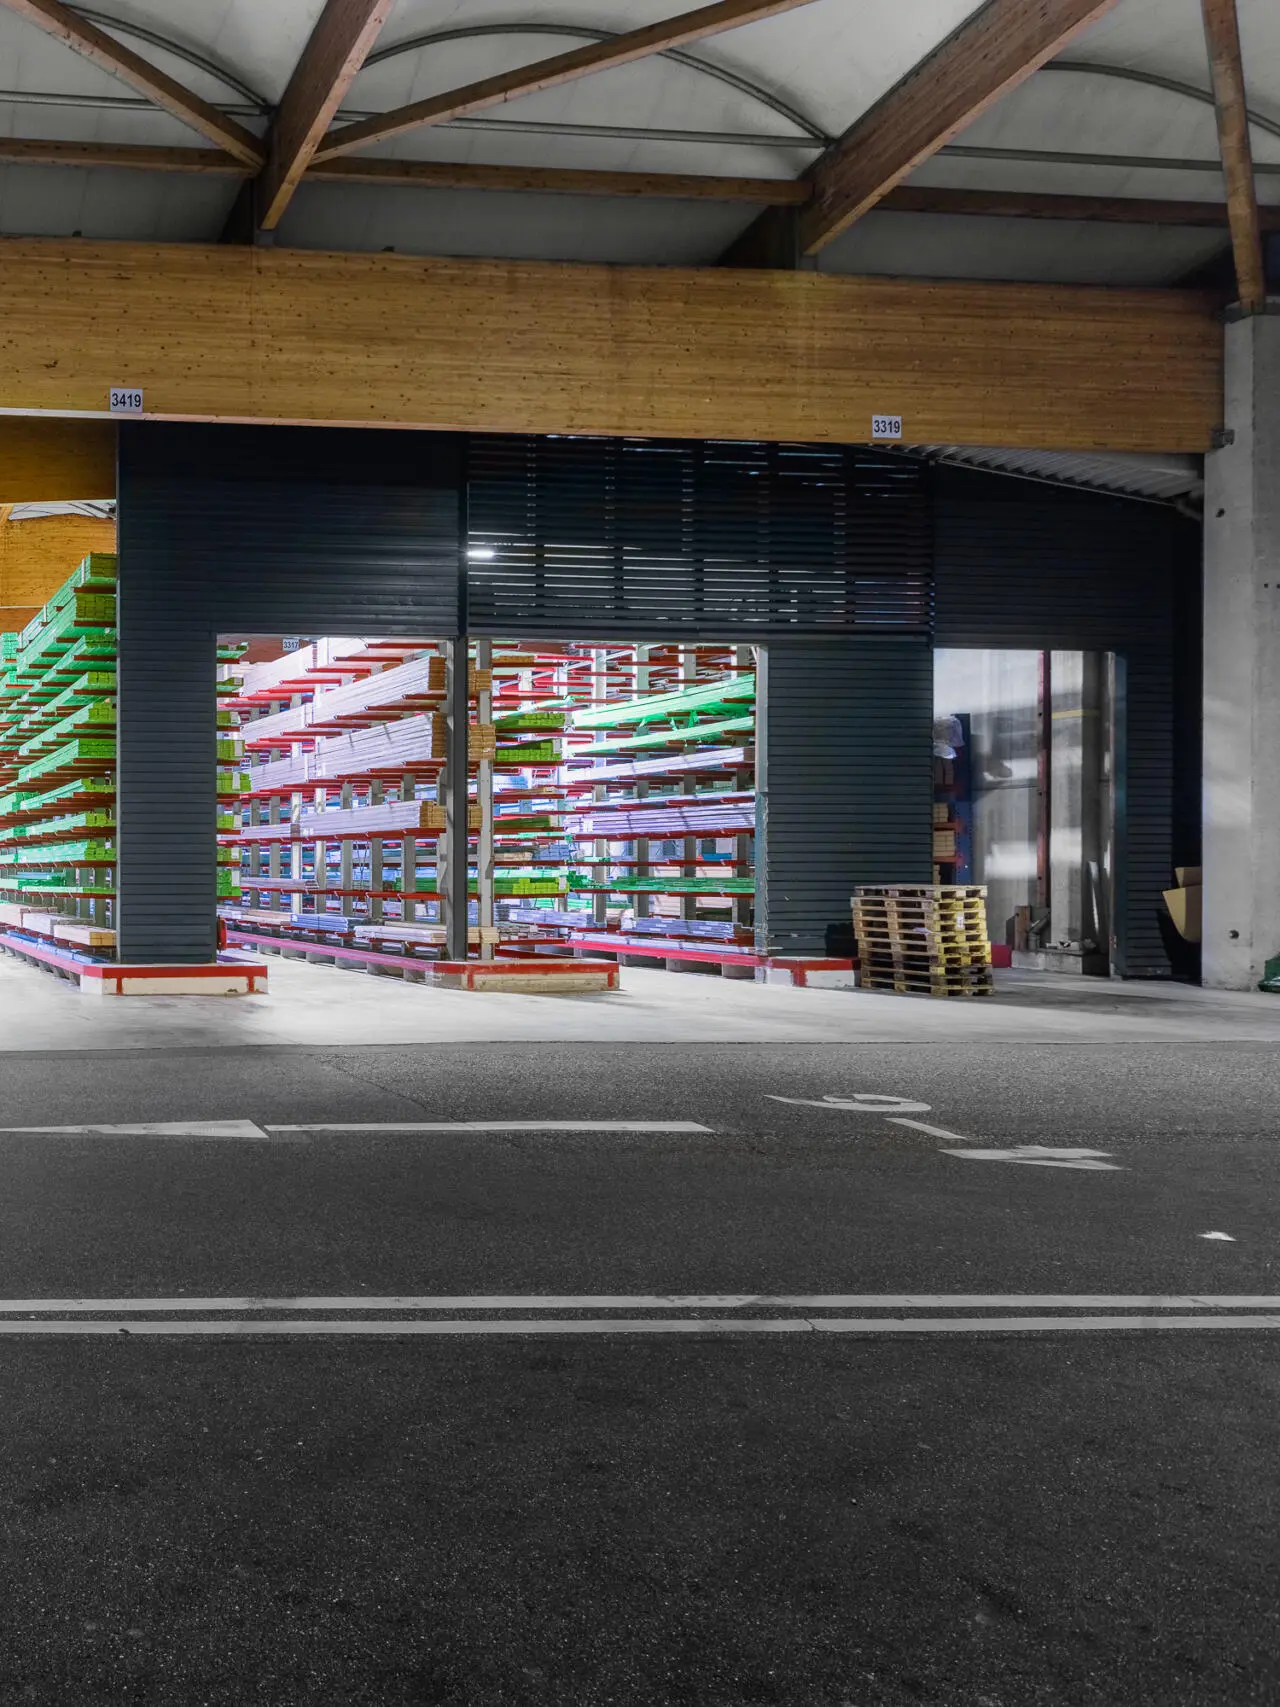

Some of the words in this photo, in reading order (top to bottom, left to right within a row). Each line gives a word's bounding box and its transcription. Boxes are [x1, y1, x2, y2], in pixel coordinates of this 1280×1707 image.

[111, 393, 142, 408] 3419
[873, 420, 901, 434] 3319
[283, 641, 299, 649] 3317
